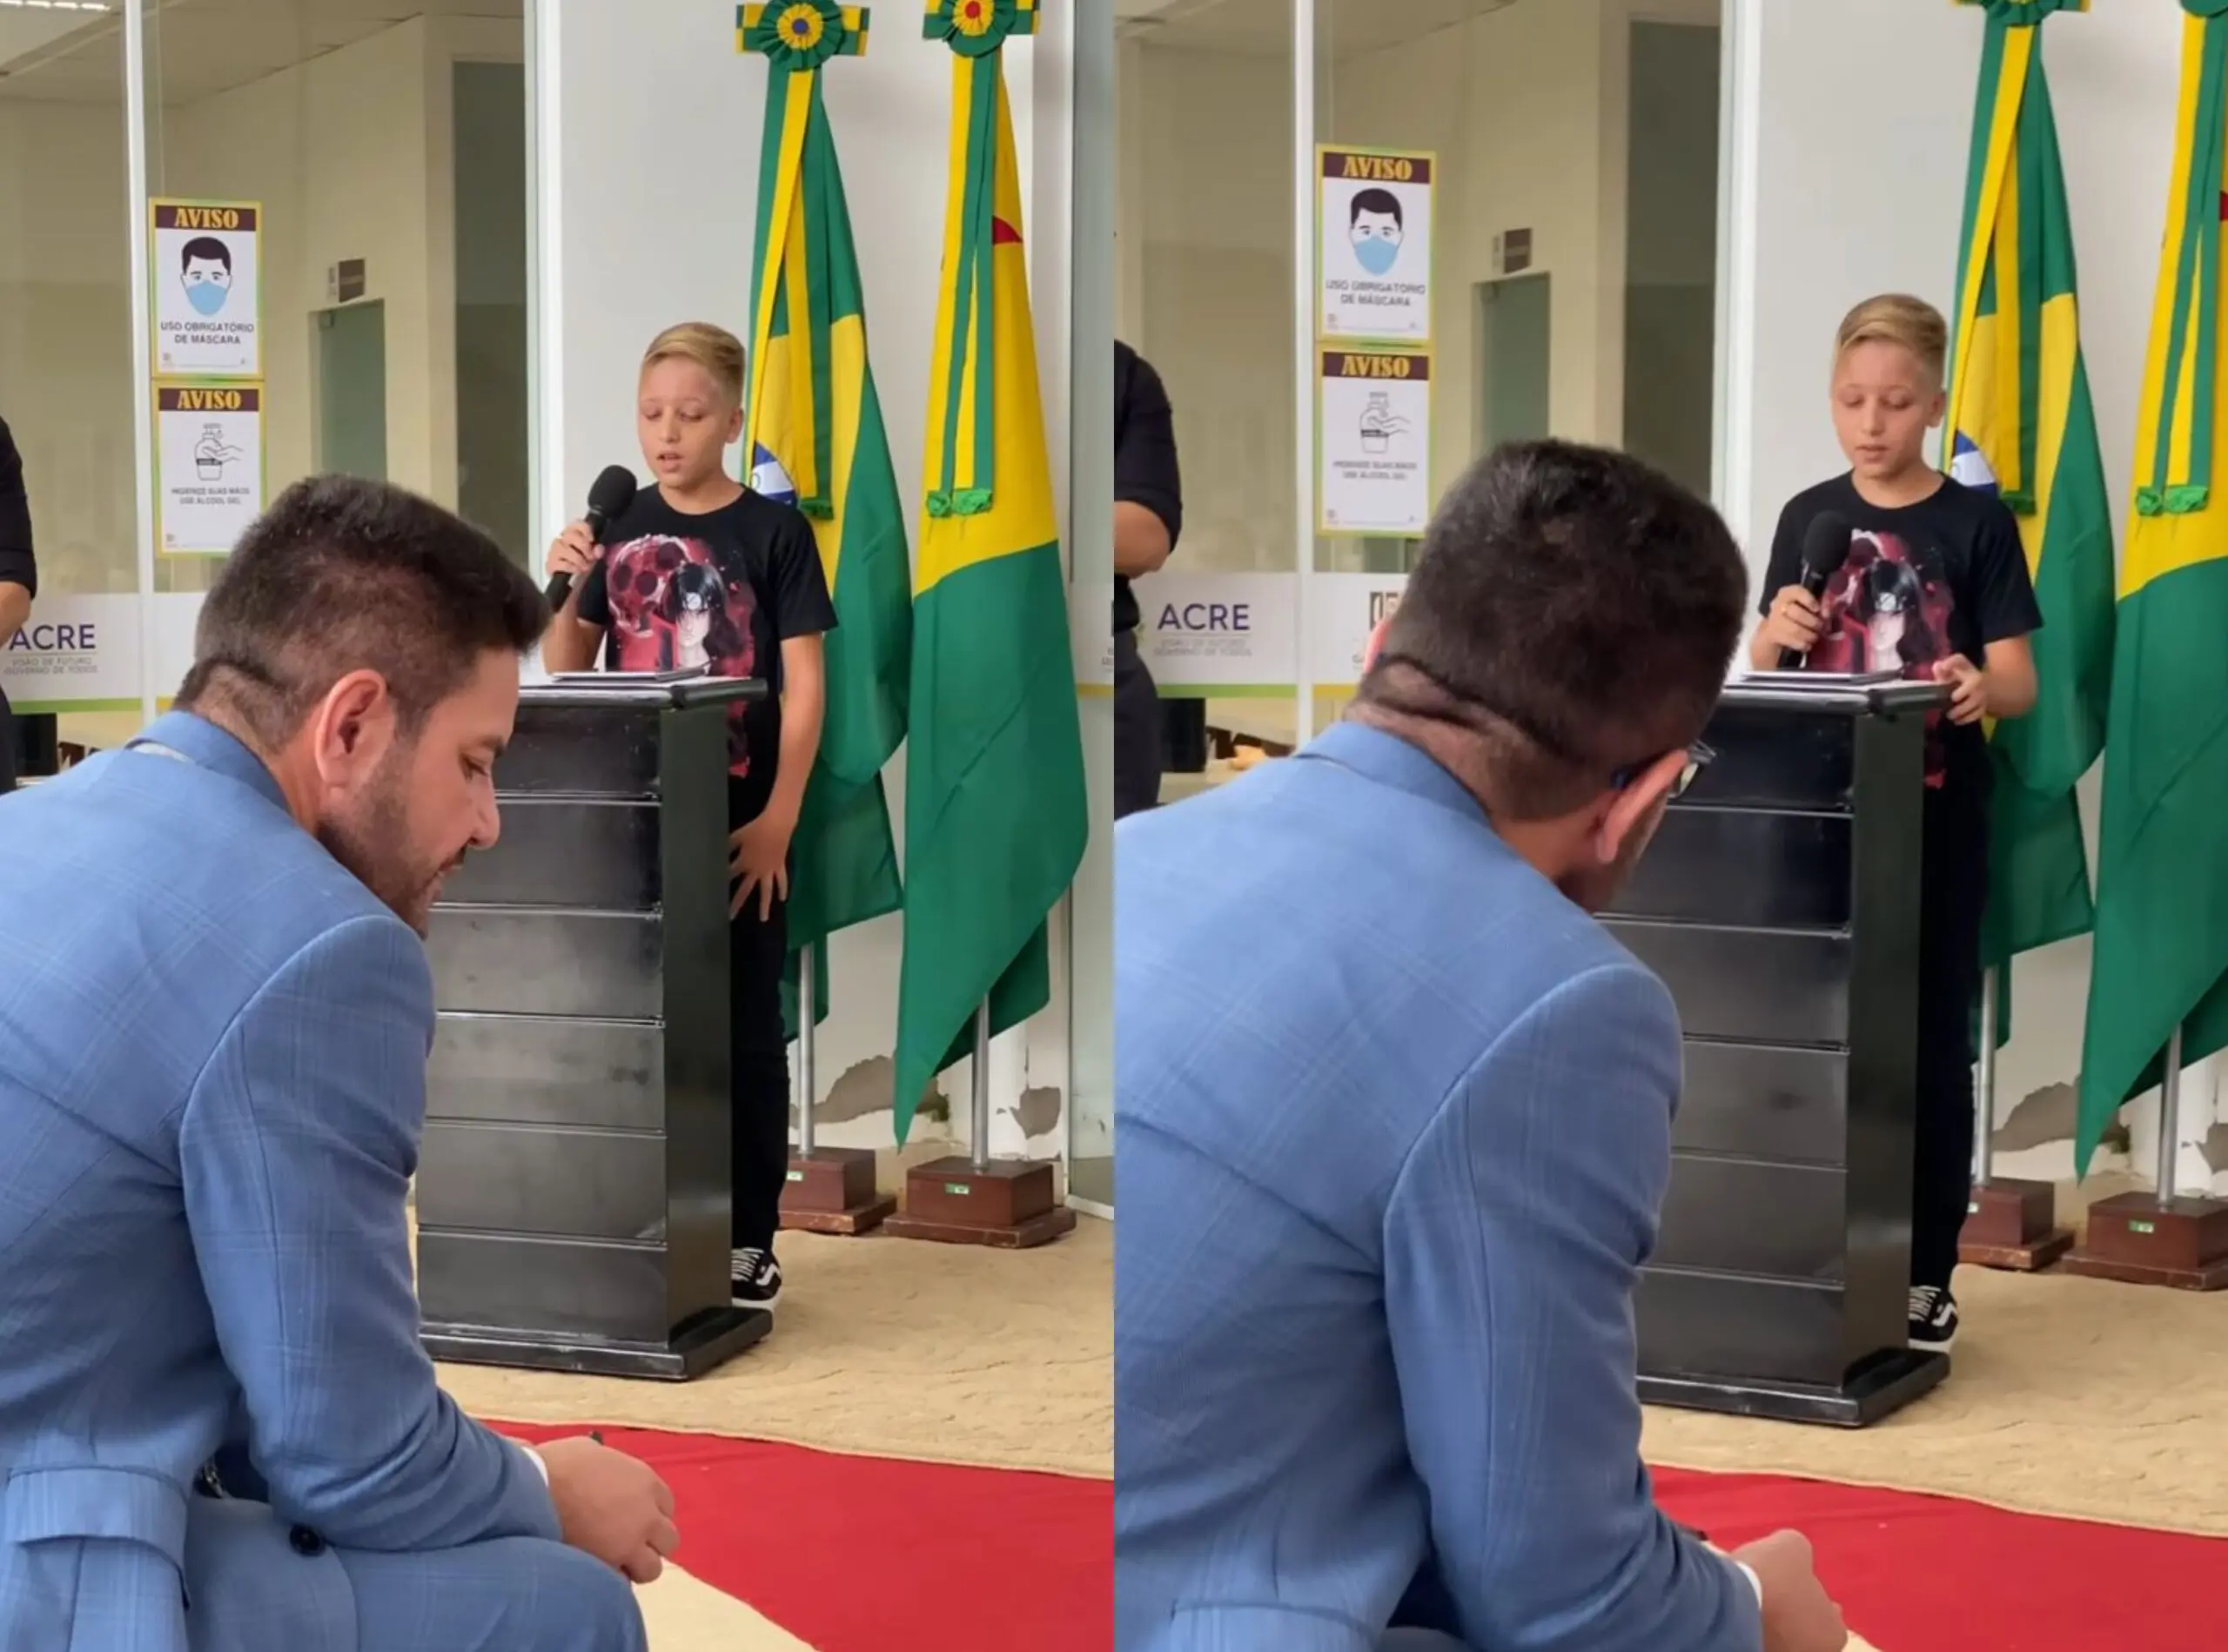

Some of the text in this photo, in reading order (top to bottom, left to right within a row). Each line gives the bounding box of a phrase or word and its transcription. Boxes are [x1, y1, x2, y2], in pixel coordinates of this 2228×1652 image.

[1342, 155, 1413, 181] AVISO
[174, 207, 239, 229] AVISO
[1341, 293, 1355, 304] DE
[160, 321, 182, 331] USO
[174, 332, 241, 345] DE MÁSCARA
[1341, 355, 1411, 378] AVISO
[177, 390, 242, 410] AVISO
[1157, 602, 1251, 631] ACRE
[9, 622, 97, 651] ACRE
